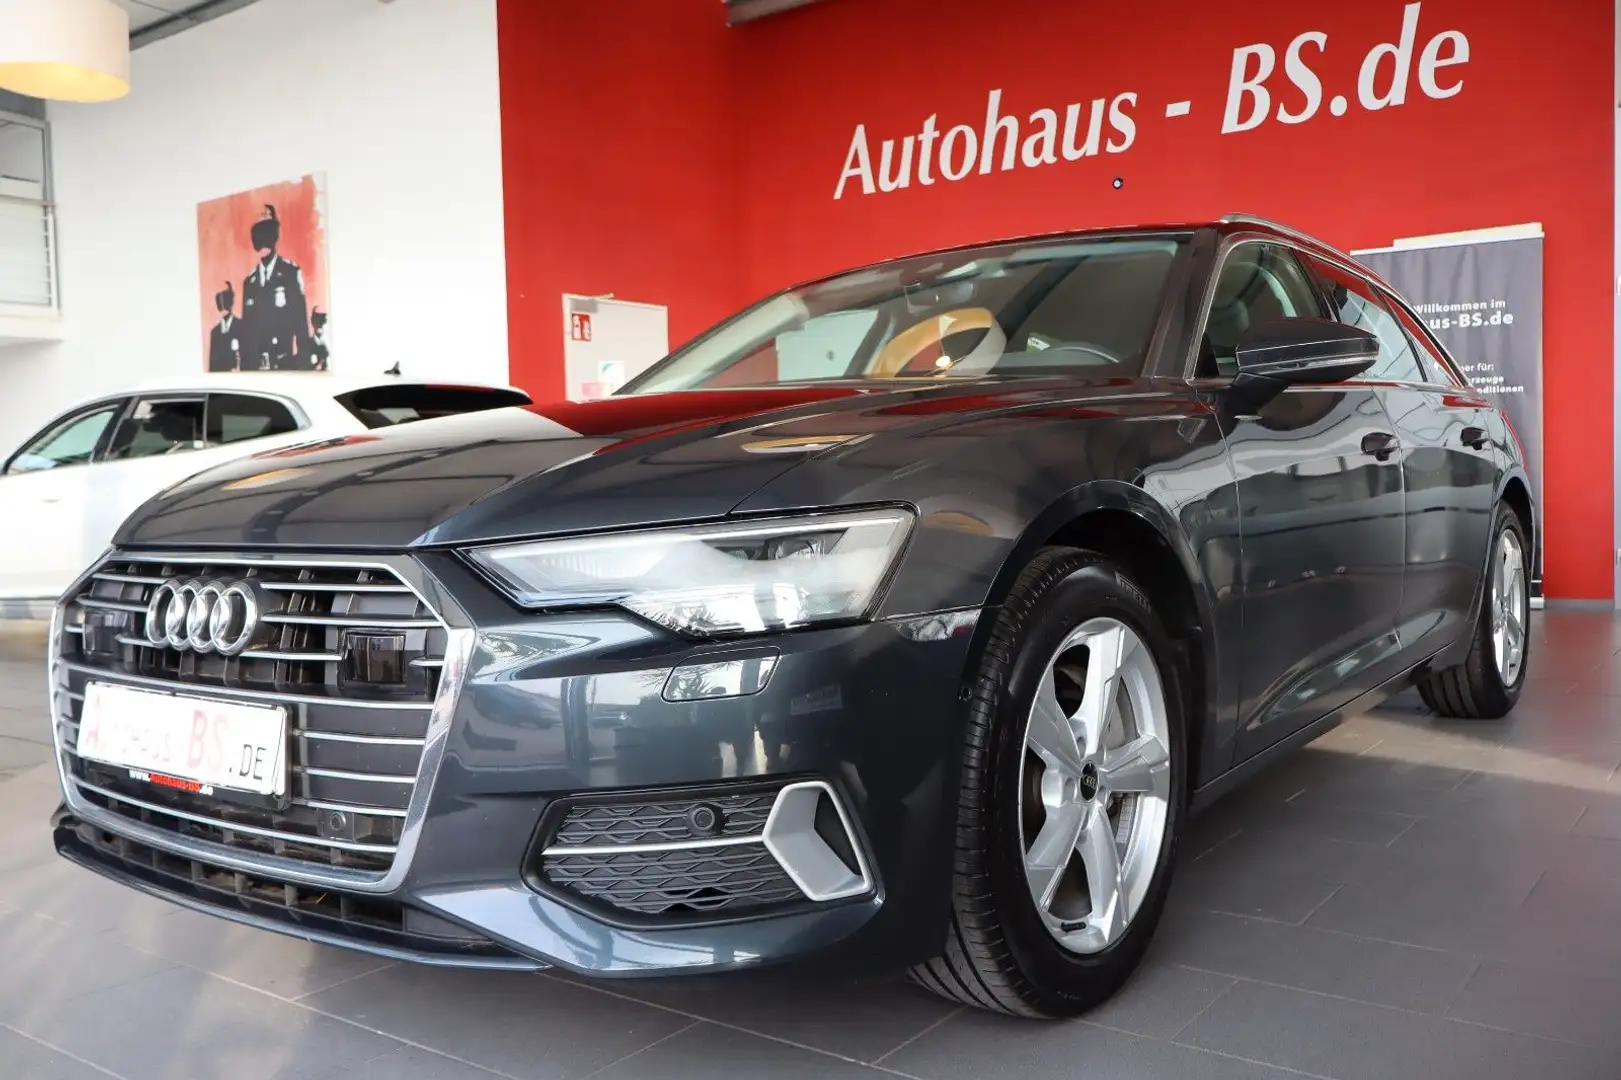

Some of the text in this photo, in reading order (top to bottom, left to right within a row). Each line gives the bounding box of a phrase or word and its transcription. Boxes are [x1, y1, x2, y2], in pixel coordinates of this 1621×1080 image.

[833, 88, 1138, 200] Autohaus
[1221, 2, 1470, 134] BS.de
[1413, 299, 1506, 314] Willkommen im
[1428, 310, 1514, 330] us-BS.de
[1469, 376, 1504, 385] rzeuge
